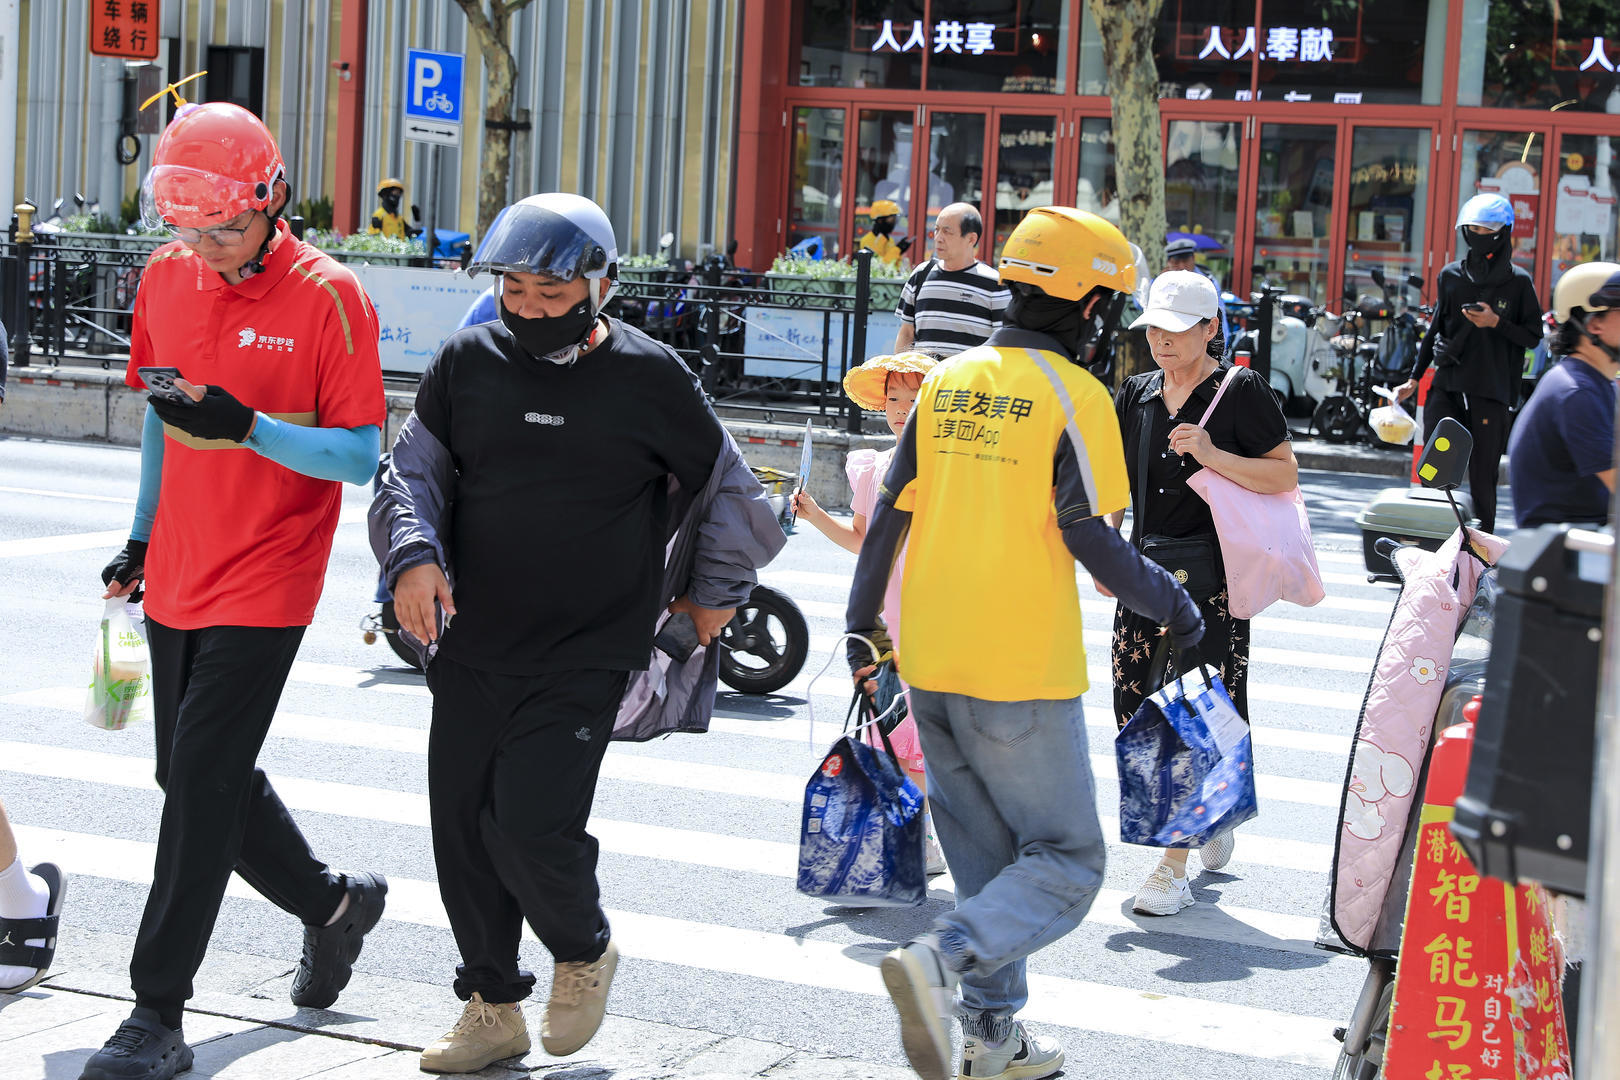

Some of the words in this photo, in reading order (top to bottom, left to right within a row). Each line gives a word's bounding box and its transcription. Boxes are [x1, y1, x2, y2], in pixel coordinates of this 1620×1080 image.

[104, 0, 148, 24] 车辆
[103, 26, 147, 51] 绕行
[871, 19, 996, 55] 人人共享
[1198, 25, 1334, 62] 人人奉献
[1579, 36, 1620, 72] 人
[413, 57, 443, 107] P
[258, 335, 295, 347] 京东秒送
[933, 388, 1034, 423] 团美发美甲
